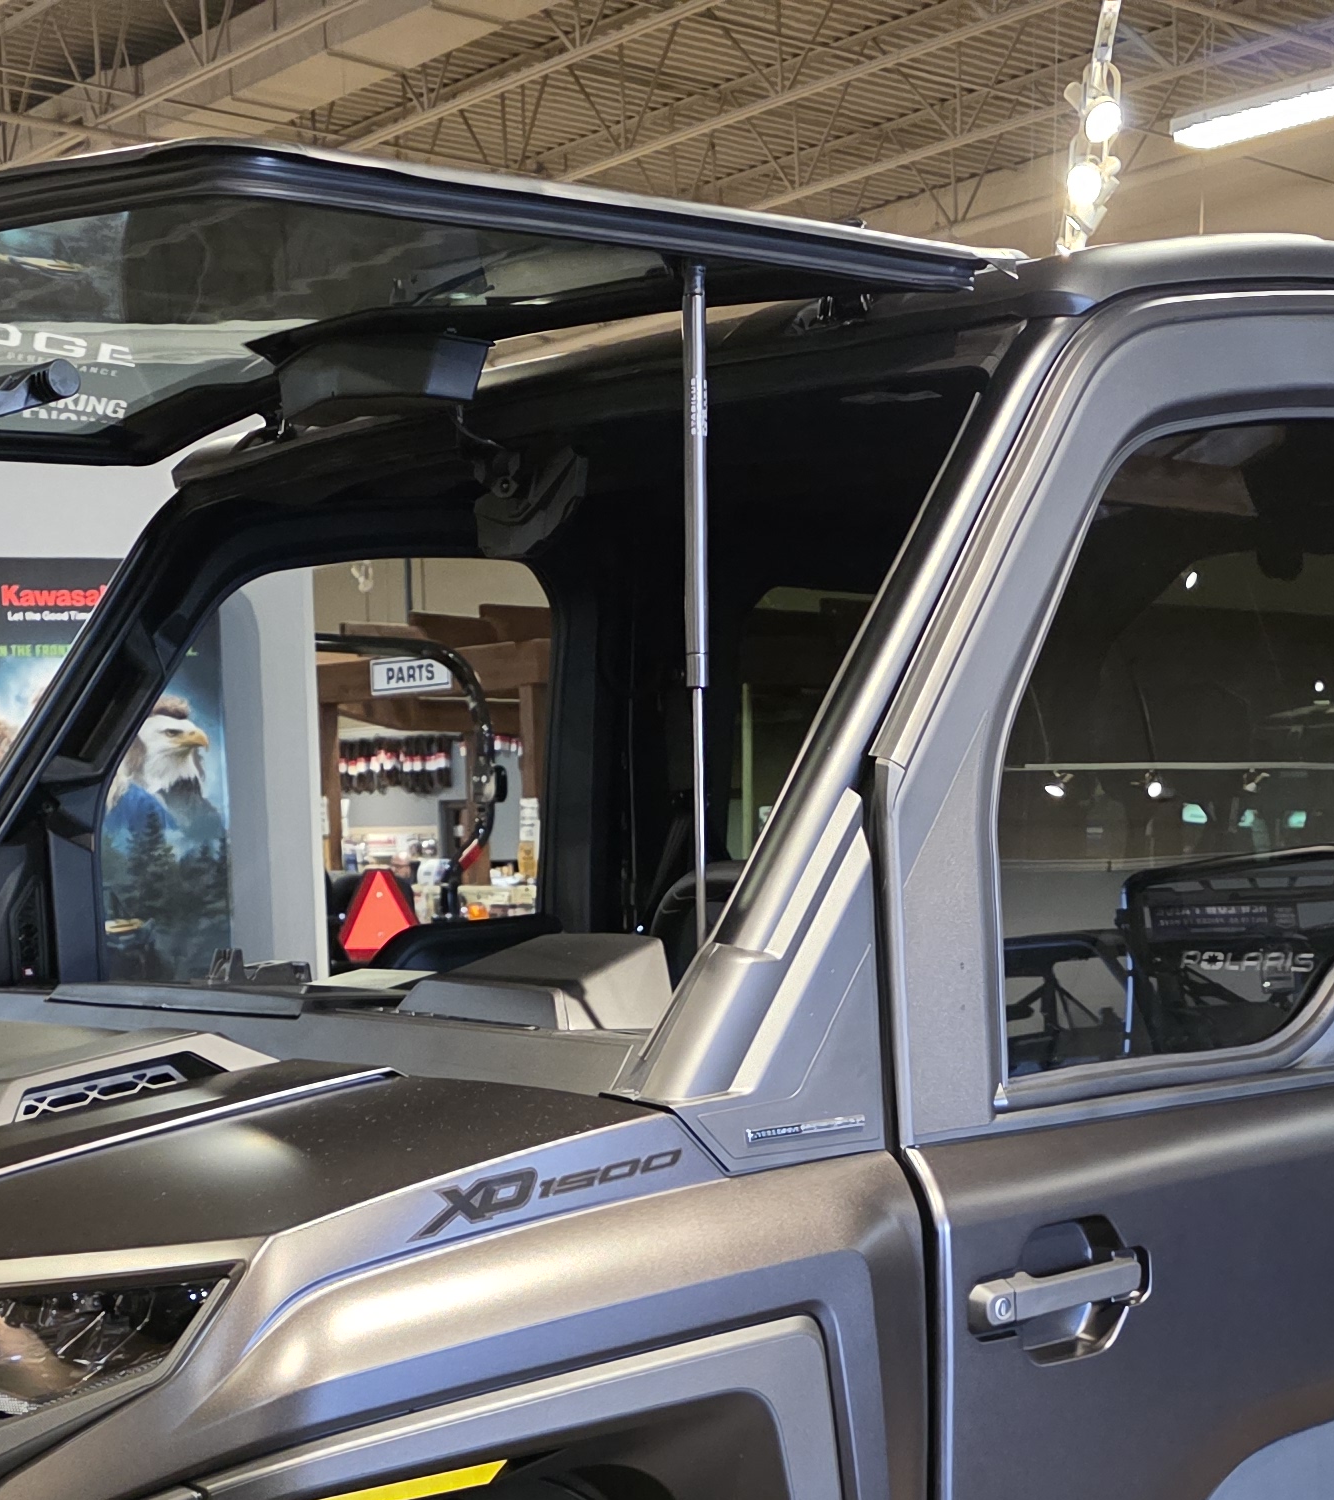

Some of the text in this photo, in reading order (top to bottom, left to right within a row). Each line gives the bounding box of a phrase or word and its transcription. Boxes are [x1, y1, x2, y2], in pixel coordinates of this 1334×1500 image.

[7, 351, 120, 377] PERFANCE
[42, 610, 69, 621] Good
[10, 643, 33, 657] THE
[385, 662, 436, 685] PARTS
[1179, 949, 1315, 973] POLARIS
[406, 1147, 682, 1244] XD 1500
